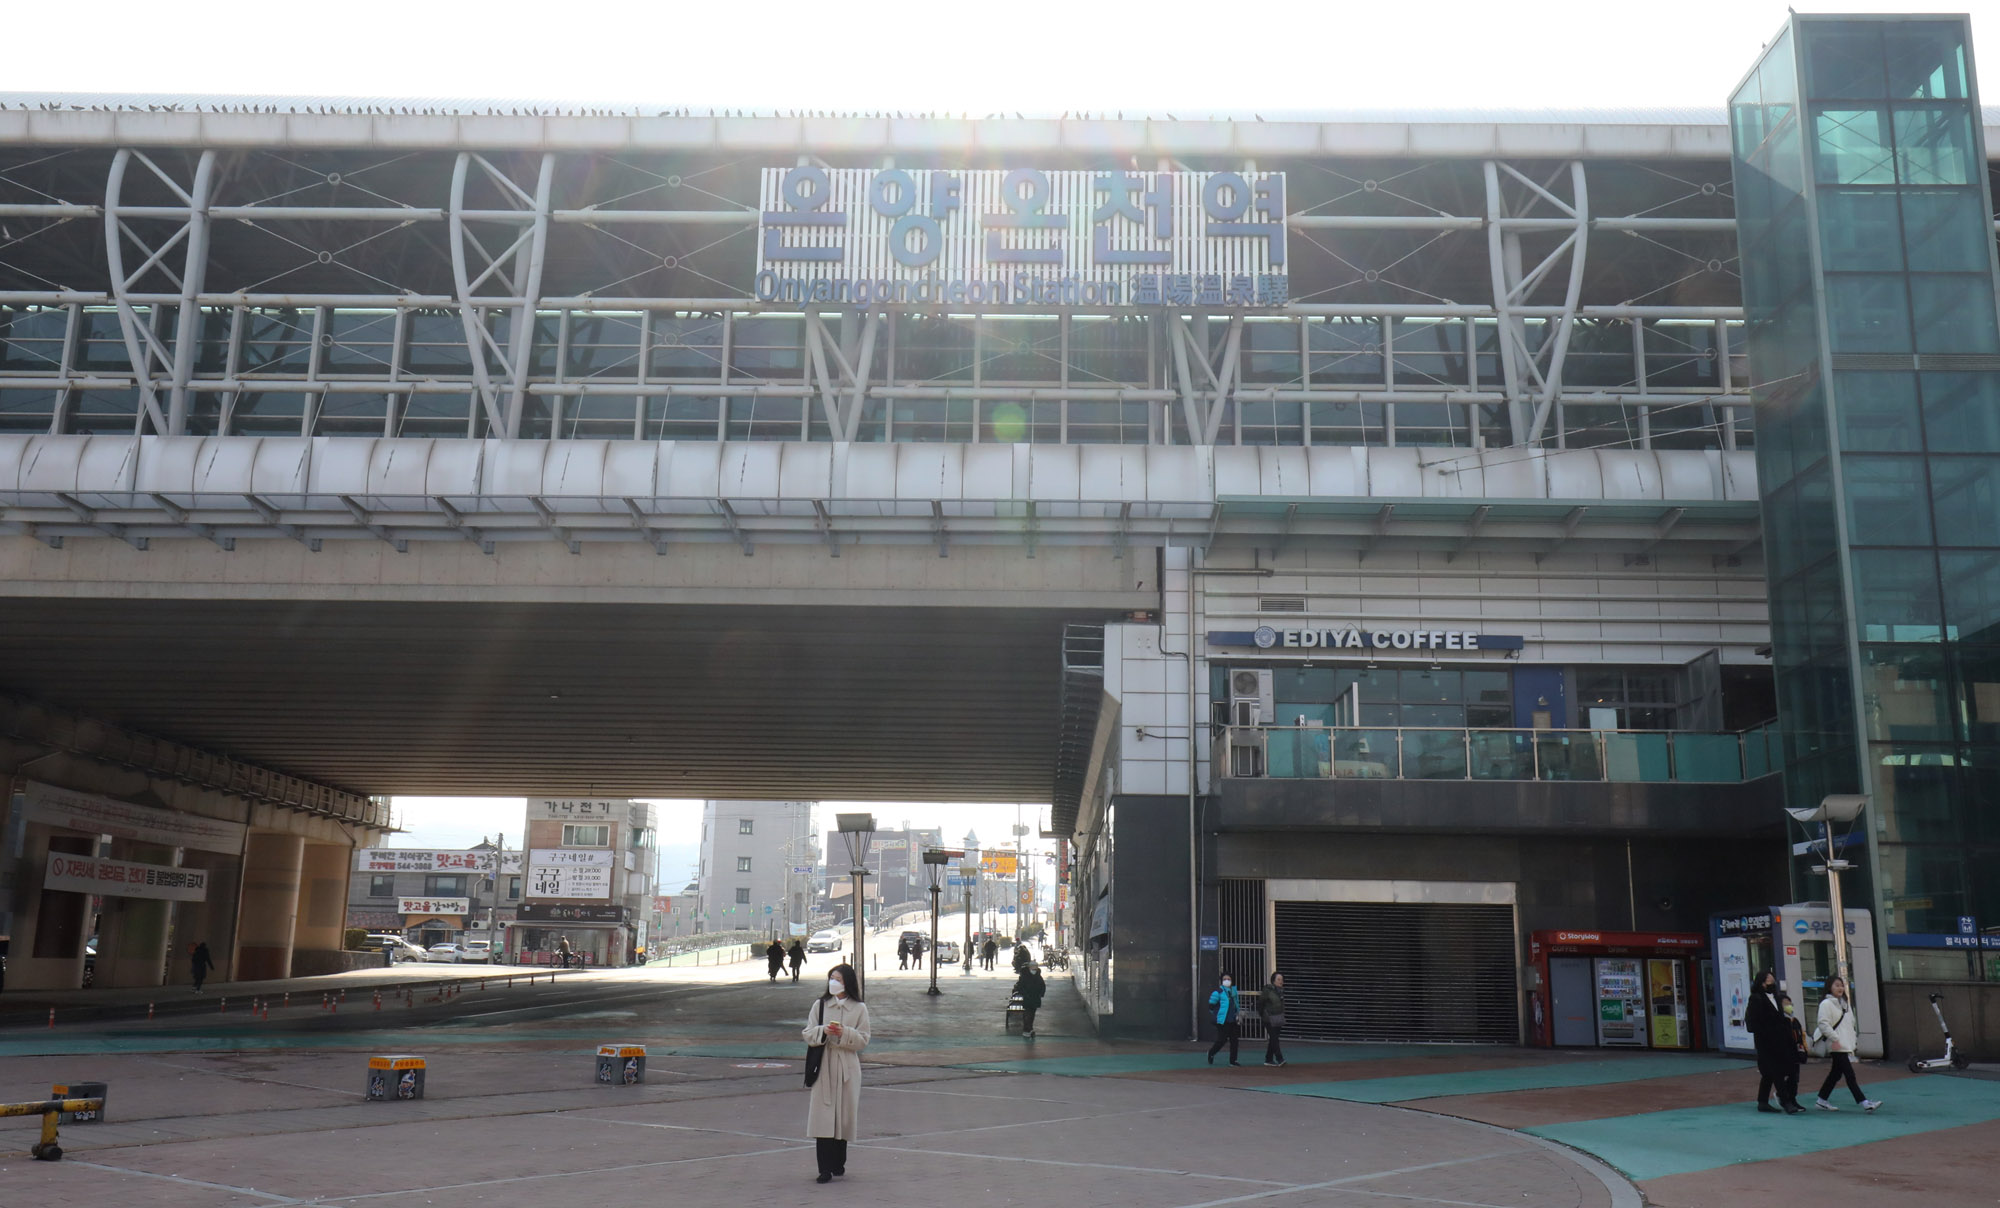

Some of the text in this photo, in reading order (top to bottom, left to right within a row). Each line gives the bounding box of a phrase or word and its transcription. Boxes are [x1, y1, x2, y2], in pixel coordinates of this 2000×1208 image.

[762, 167, 1284, 268] 온양온천역
[755, 268, 1119, 309] Onyangoncheon Station
[1282, 628, 1364, 649] EDIYA
[1371, 629, 1479, 650] COFFEE
[544, 801, 610, 813] 가나전기
[436, 853, 477, 869] 맛고을
[156, 870, 187, 887] 불법행위
[187, 873, 203, 889] 금지
[536, 868, 561, 881] 구구
[535, 881, 560, 895] 네일
[403, 901, 431, 912] 맛고을
[1810, 920, 1856, 935] 우리행
[1945, 936, 1989, 946] 엘리베이터
